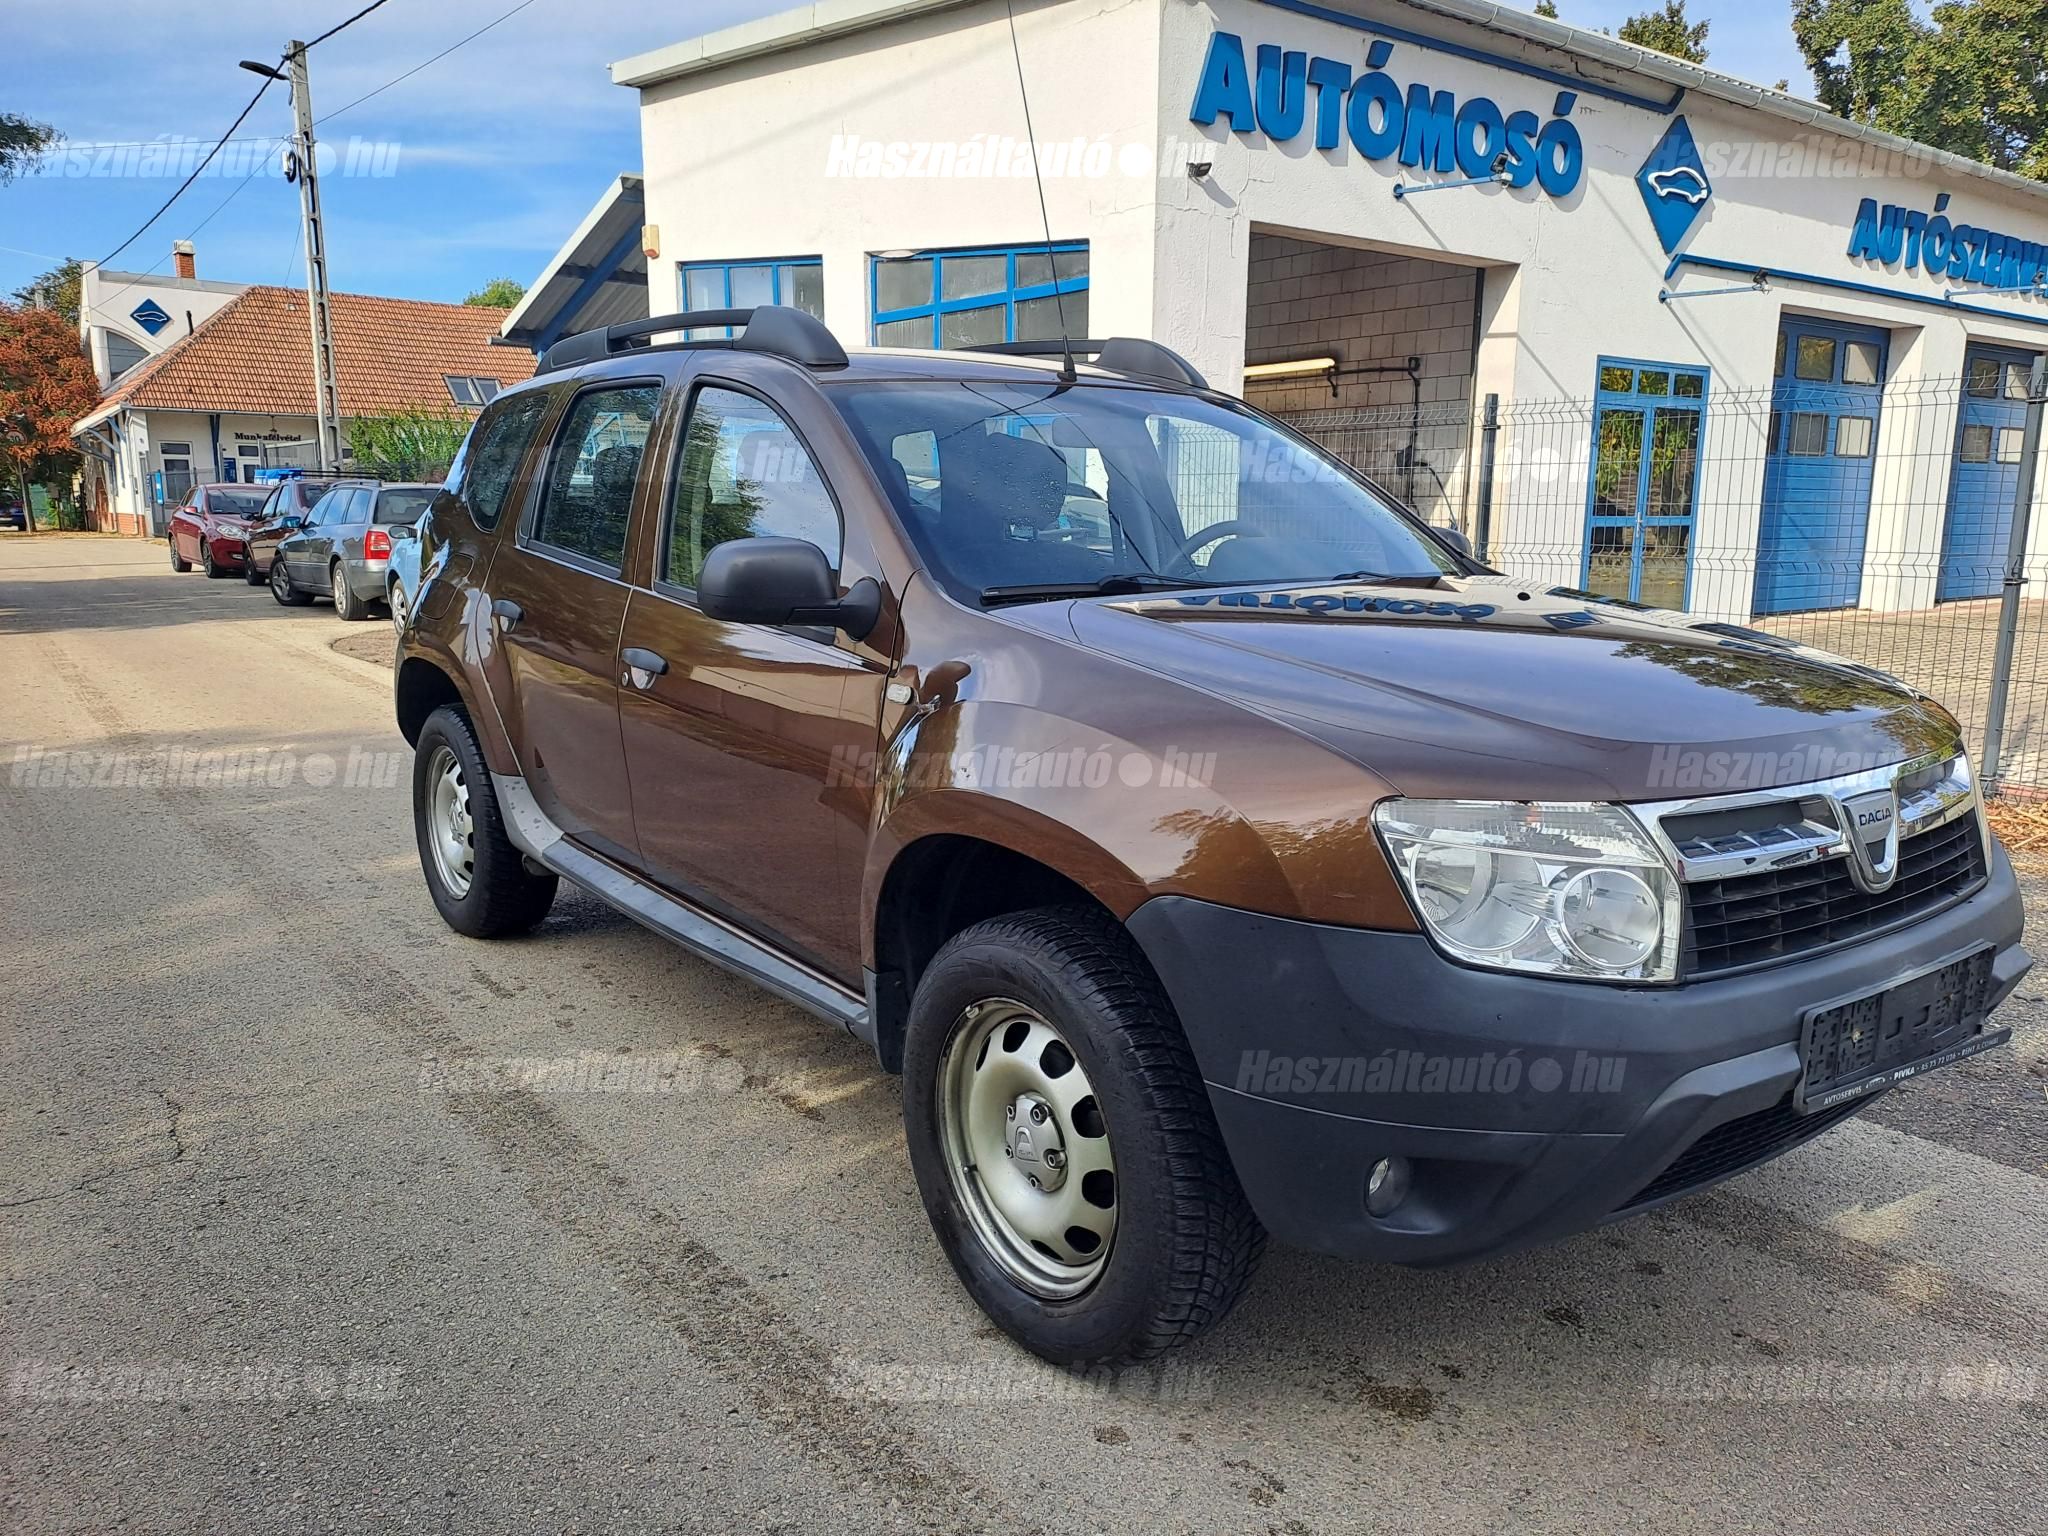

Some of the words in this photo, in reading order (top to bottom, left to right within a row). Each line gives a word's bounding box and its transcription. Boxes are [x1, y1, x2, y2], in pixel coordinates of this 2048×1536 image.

[1189, 31, 1583, 197] AUTÓMOSÓ
[1858, 807, 1891, 826] DACIA
[1823, 1086, 1862, 1105] AVTOSERVIS
[1893, 1066, 1915, 1081] PIVKA
